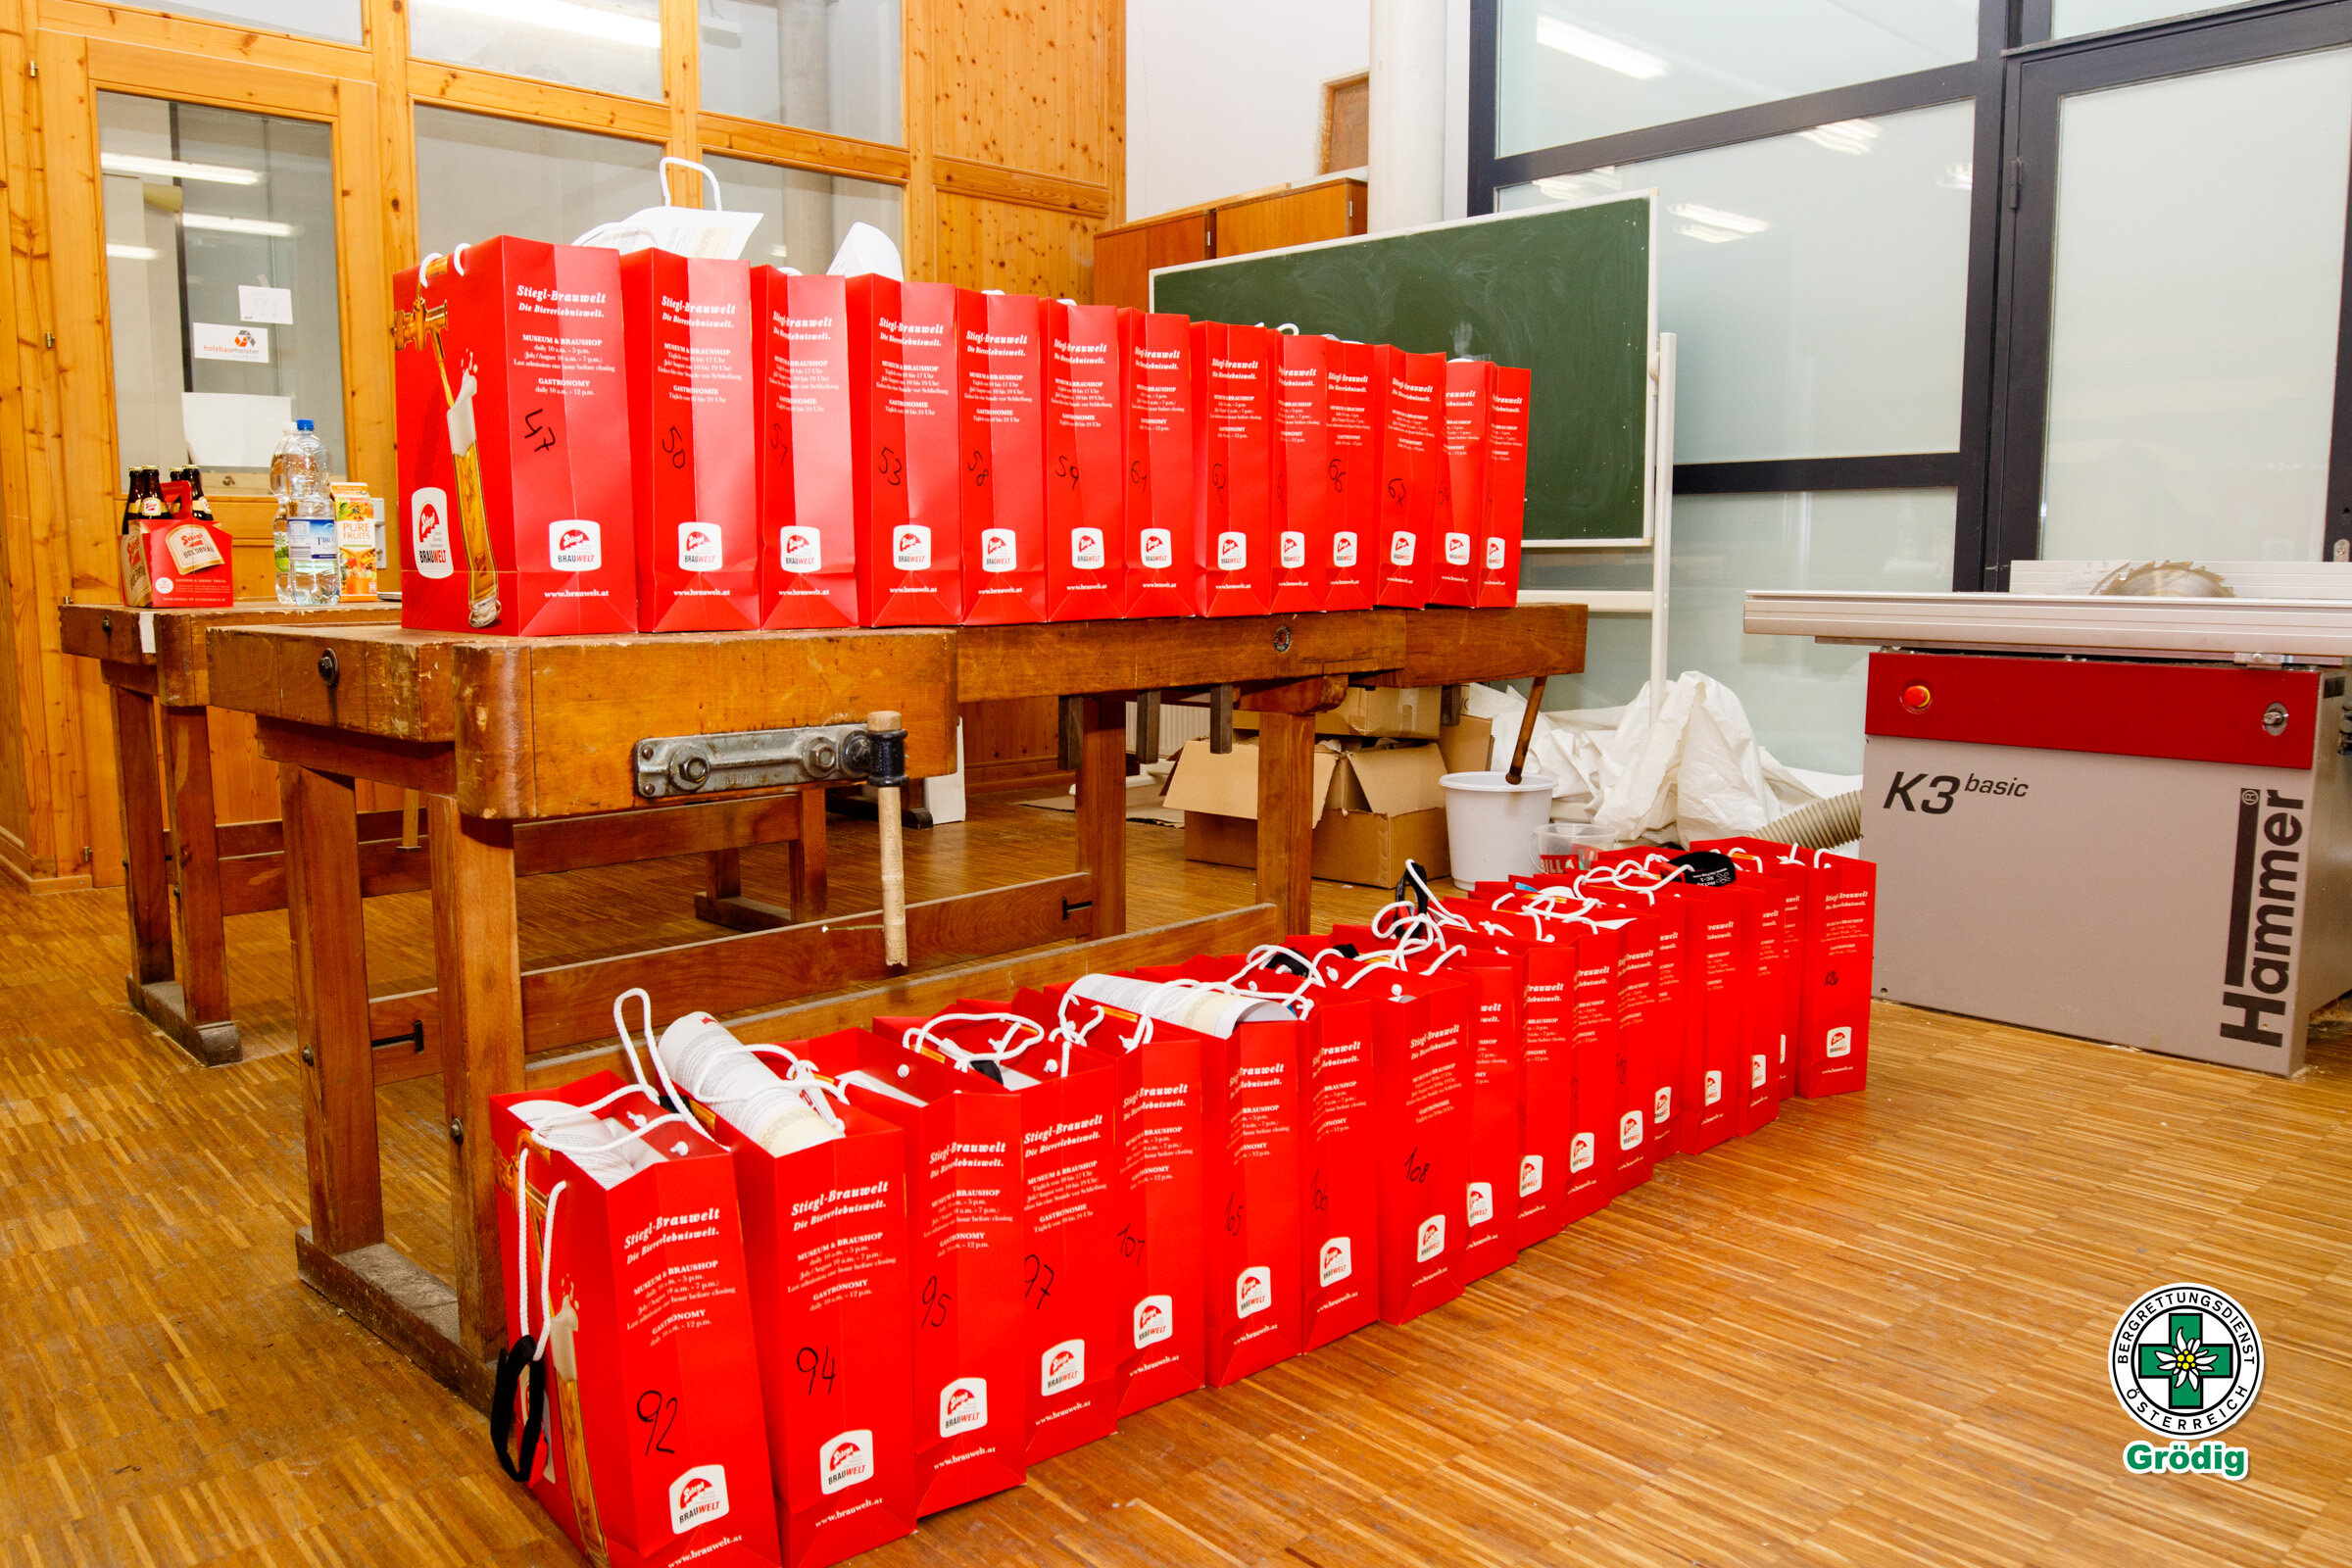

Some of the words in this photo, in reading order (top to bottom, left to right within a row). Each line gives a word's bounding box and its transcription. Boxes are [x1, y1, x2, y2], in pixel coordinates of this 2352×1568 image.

[516, 284, 607, 303] Stiegl-Brauwelt
[662, 295, 736, 314] Stiegl-Brauwelt
[518, 302, 532, 313] Die
[534, 304, 605, 318] Biererlebniswelt.
[662, 312, 672, 322] Die
[879, 317, 944, 334] Stiegl-Brauwelt
[522, 334, 553, 344] MUSEUM
[966, 330, 1027, 345] Stiegl-Brauwelt
[203, 344, 260, 355] holzbaumeister
[538, 378, 590, 387] GASTRONOMY
[524, 409, 557, 453] 47
[662, 426, 686, 468] 50
[878, 447, 903, 486] 53
[967, 450, 989, 486] 58
[343, 522, 369, 531] PURE
[419, 550, 447, 564] BRAUWELT
[558, 555, 595, 564] BRAUWELT
[684, 555, 715, 564] BRAUWELT
[544, 590, 610, 599] www.brauwelt.at
[1882, 771, 1961, 815] K3
[1964, 773, 2030, 798] basic
[2219, 788, 2305, 1049] Hammer
[1023, 1114, 1102, 1145] Stiegl-Brauwelt
[929, 1141, 1006, 1164] Stiegl-Brauwelt
[1025, 1149, 1038, 1158] Die
[1403, 1147, 1430, 1184] 108
[791, 1181, 889, 1216] Stiegl-Brauwelt
[956, 1189, 1001, 1198] BRAUSHOP
[793, 1220, 808, 1232] Die
[810, 1200, 887, 1226] Biererlebniswelt.
[624, 1207, 720, 1250] Stiegl-Brauwelt
[627, 1252, 640, 1264] Die
[798, 1244, 829, 1261] MUSEUM
[837, 1232, 883, 1247] BRAUSHOP
[634, 1273, 662, 1296] MUSEUM
[667, 1260, 718, 1275] BRAUSHOP
[812, 1279, 868, 1301] GASTRONOMY
[920, 1275, 952, 1330] 95
[652, 1309, 706, 1335] GASTRONOMY
[796, 1346, 836, 1396] 94
[1047, 1370, 1079, 1389] BRAUWELT
[636, 1390, 678, 1456] 92
[945, 1411, 980, 1429] BRAUWELT
[1035, 1400, 1092, 1426] www.brauwelt.at
[933, 1446, 996, 1470] www.brauwelt.at
[827, 1465, 866, 1486] BRAUWELT
[678, 1500, 720, 1524] BRAUWELT
[814, 1497, 884, 1528] www.brauwelt.at
[667, 1535, 743, 1568] www.brauwelt.at
